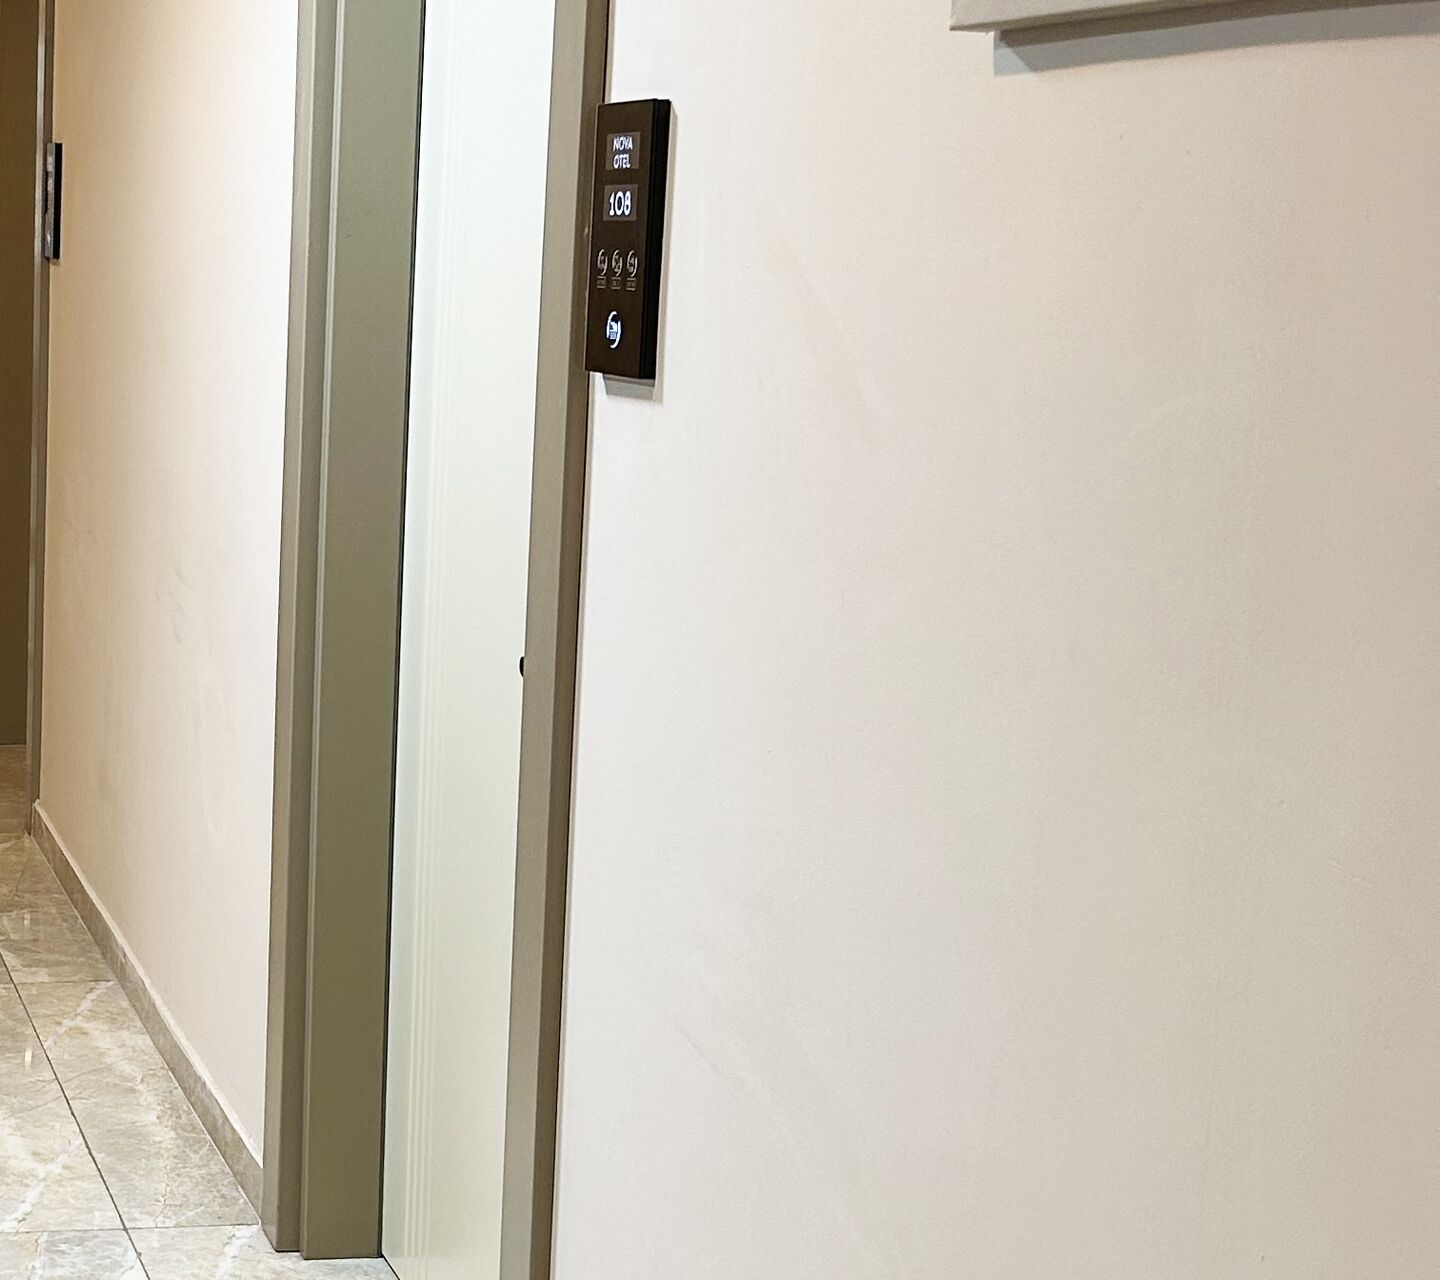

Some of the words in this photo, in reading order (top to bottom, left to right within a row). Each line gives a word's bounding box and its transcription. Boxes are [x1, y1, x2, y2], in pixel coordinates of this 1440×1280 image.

[613, 136, 633, 152] NOVA
[613, 153, 631, 169] OTEL
[609, 190, 632, 216] 108
